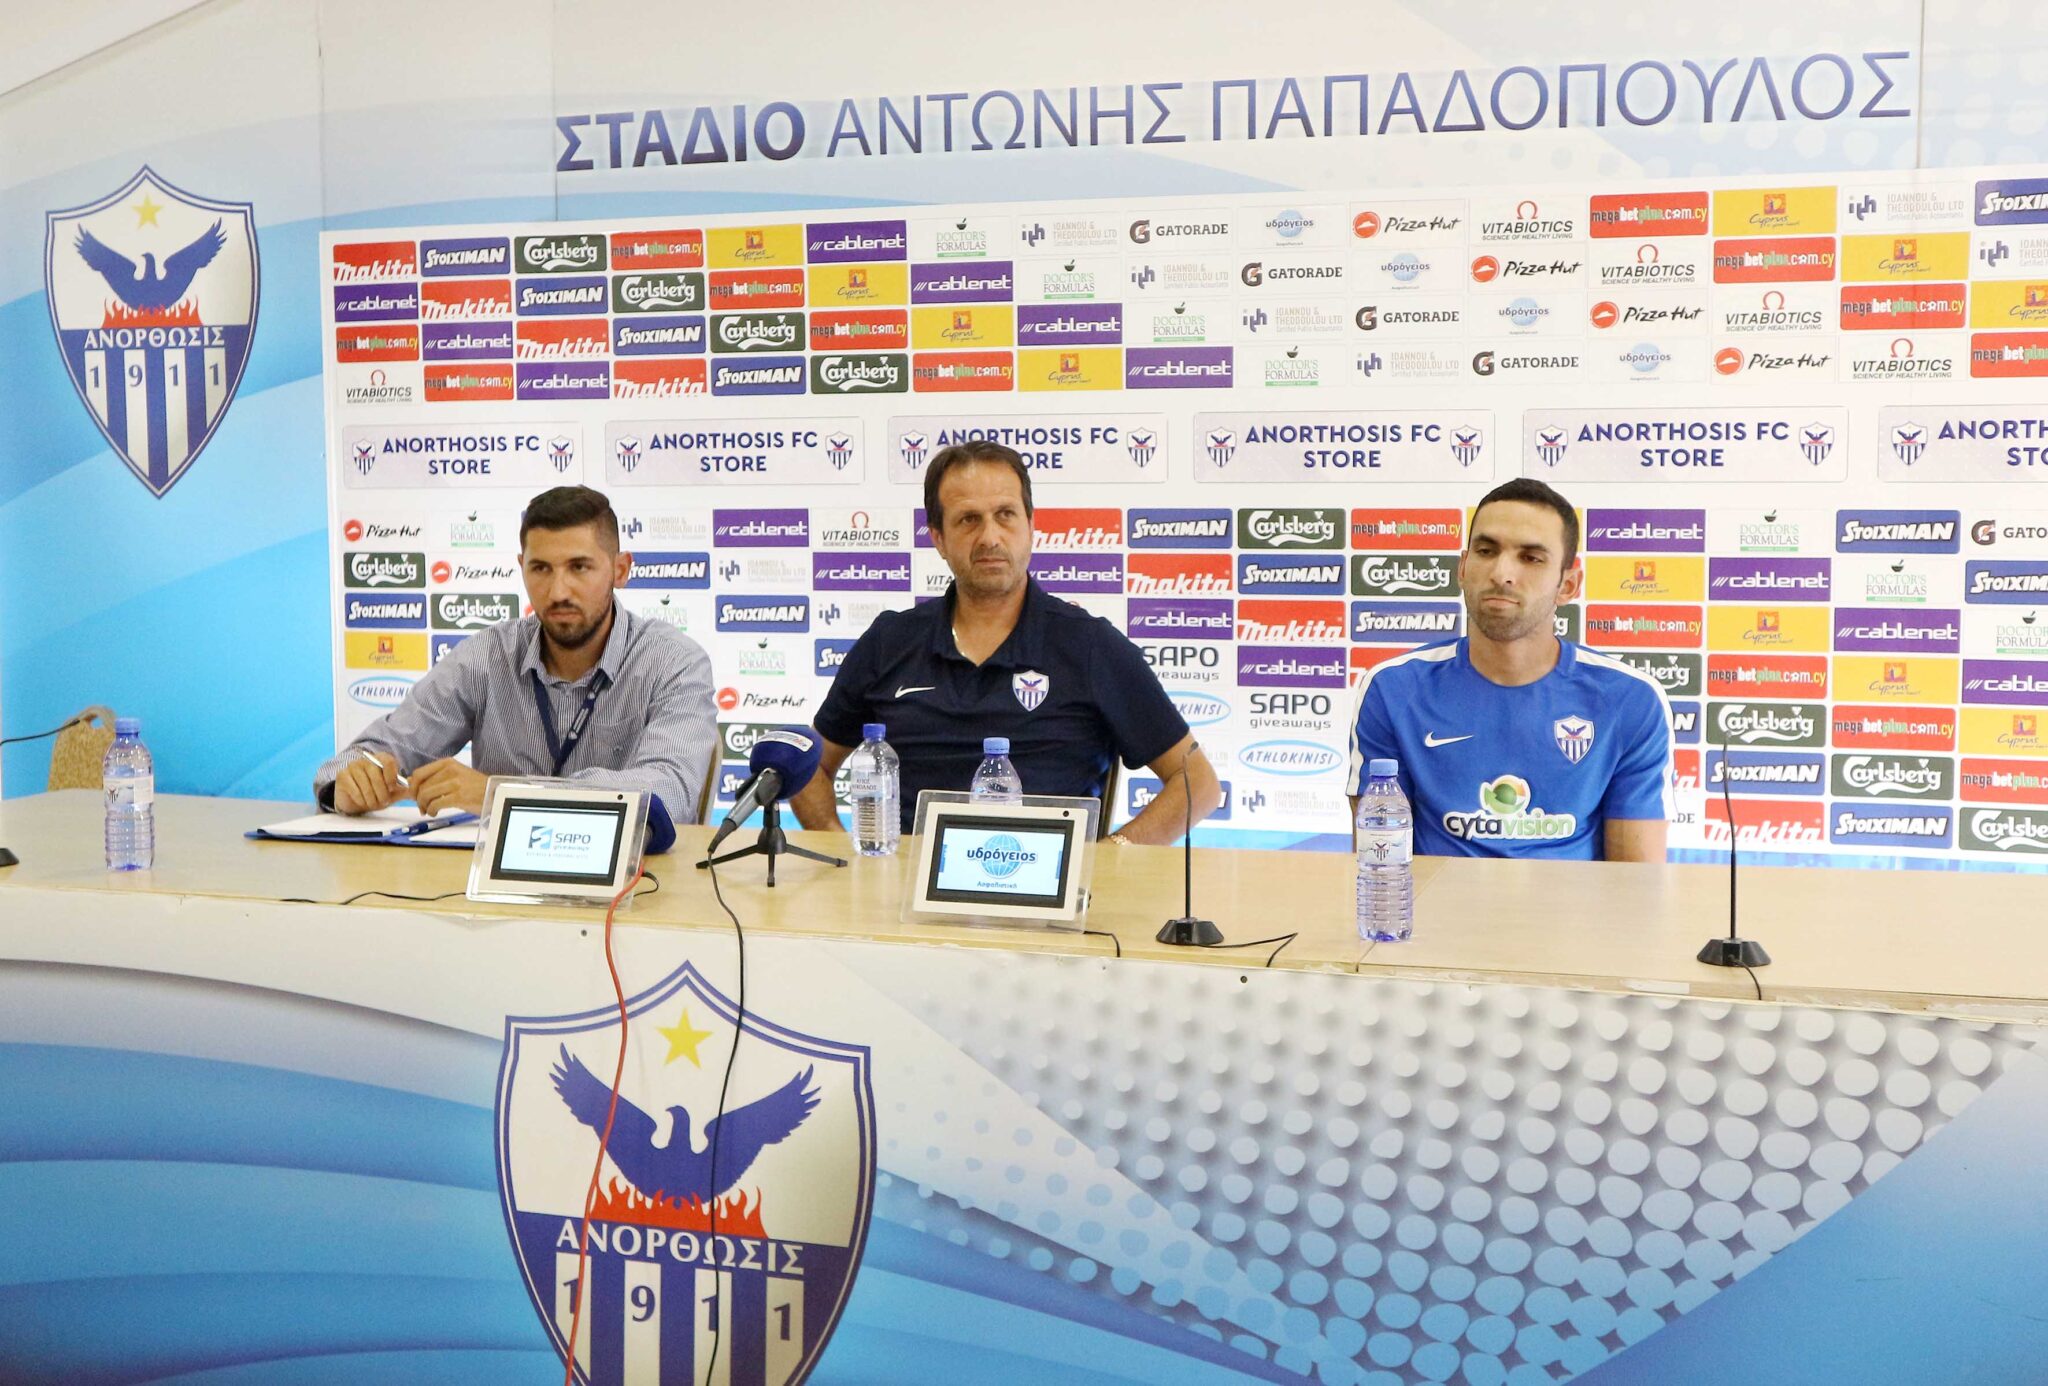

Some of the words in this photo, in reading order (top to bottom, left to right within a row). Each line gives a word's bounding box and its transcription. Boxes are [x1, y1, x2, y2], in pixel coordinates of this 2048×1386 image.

[555, 100, 806, 172] ΣΤΑΔΙΟ
[827, 82, 1186, 158] ΑΝΤΩΝΗΣ
[1212, 51, 1911, 142] ΠΑΠΑΔΟΠΟΥΛΟΣ
[1385, 217, 1427, 233] Pizza
[1430, 216, 1462, 230] Hut
[1482, 221, 1573, 234] VITABIOTICS
[1749, 214, 1788, 227] Cyprus
[1156, 223, 1228, 236] GATORADE
[824, 233, 905, 251] cablenet
[425, 247, 506, 269] STOIXIMAN
[524, 237, 598, 268] Carlsberg
[735, 247, 767, 259] Cyprus
[1268, 266, 1342, 279] GATORADE
[1503, 261, 1547, 277] Pizza
[1550, 261, 1583, 275] Hut
[1601, 264, 1695, 278] VITABIOTICS
[1879, 258, 1920, 274] Cyprus
[621, 276, 695, 308] Carlsberg
[838, 286, 871, 298] Cyprus
[928, 275, 1011, 292] cablenet
[348, 294, 417, 312] cablenet
[521, 287, 603, 308] STOIXIMAN
[1383, 311, 1459, 323] GATORADE
[1624, 307, 1668, 322] Pizza
[1670, 306, 1705, 321] Hut
[1725, 311, 1822, 325] VITABIOTICS
[719, 316, 795, 349] Carlsberg
[1034, 317, 1120, 335] cablenet
[84, 327, 225, 349] ΑΝΟΡΘΩΣΙΣ
[437, 334, 512, 350] cablenet
[617, 326, 702, 347] STOIXIMAN
[1143, 361, 1232, 377] cablenet
[1501, 356, 1579, 369] GATORADE
[1748, 353, 1794, 370] Pizza
[1797, 354, 1832, 368] Hut
[1852, 359, 1951, 372] VITABIOTICS
[532, 373, 608, 390] cablenet
[715, 366, 802, 387] STOIXIMAN
[819, 356, 899, 391] Carlsberg
[346, 387, 412, 398] VITABIOTICS
[650, 432, 784, 450] ANORTHOSIS
[792, 431, 819, 447] FC
[1091, 427, 1118, 444] FC
[1245, 425, 1402, 444] ANORTHOSIS
[1411, 424, 1442, 442] FC
[1577, 422, 1747, 442] ANORTHOSIS
[1757, 422, 1789, 440] FC
[382, 436, 508, 453] ANORTHOSIS
[515, 436, 540, 452] FC
[700, 456, 767, 472] STORE
[1304, 451, 1382, 468] STORE
[1640, 449, 1724, 467] STORE
[428, 459, 491, 475] STORE
[366, 524, 397, 538] Pizza
[399, 525, 421, 537] Hut
[728, 521, 807, 537] cablenet
[822, 530, 899, 541] VITABIOTICS
[1132, 518, 1228, 539] STOIXIMAN
[1248, 511, 1335, 546] Carlsberg
[1606, 523, 1703, 540] cablenet
[1841, 519, 1955, 542] STOIXIMAN
[351, 554, 417, 584] Carlsberg
[456, 567, 489, 580] Pizza
[491, 567, 515, 578] Hut
[828, 564, 910, 581] cablenet
[1037, 565, 1122, 582] cablenet
[1242, 564, 1341, 585] STOIXIMAN
[1362, 557, 1451, 593] Carlsberg
[1620, 580, 1657, 593] Cyprus
[1729, 572, 1829, 589] cablenet
[348, 601, 423, 621] STOIXIMAN
[439, 595, 511, 626] Carlsberg
[719, 604, 805, 623] STOIXIMAN
[1145, 612, 1232, 628] cablenet
[1355, 612, 1457, 632] STOIXIMAN
[1855, 622, 1958, 640] cablenet
[1142, 646, 1219, 667] SAPO
[1255, 660, 1344, 677] cablenet
[743, 693, 779, 708] Pizza
[781, 695, 808, 708] Hut
[1250, 693, 1331, 715] SAPO
[1250, 718, 1331, 730] giveaways
[1718, 705, 1814, 738] Carlsberg
[1246, 750, 1333, 765] ATHLOKINISI
[1843, 756, 1942, 791] Carlsberg
[1446, 813, 1573, 840] cytavision
[1836, 813, 1948, 836] STOIXIMAN
[555, 832, 591, 843] SAPO
[967, 847, 1036, 863] υδρόγειος
[556, 1218, 804, 1275] ΑΝΟΡΘΩΣΙΣ
